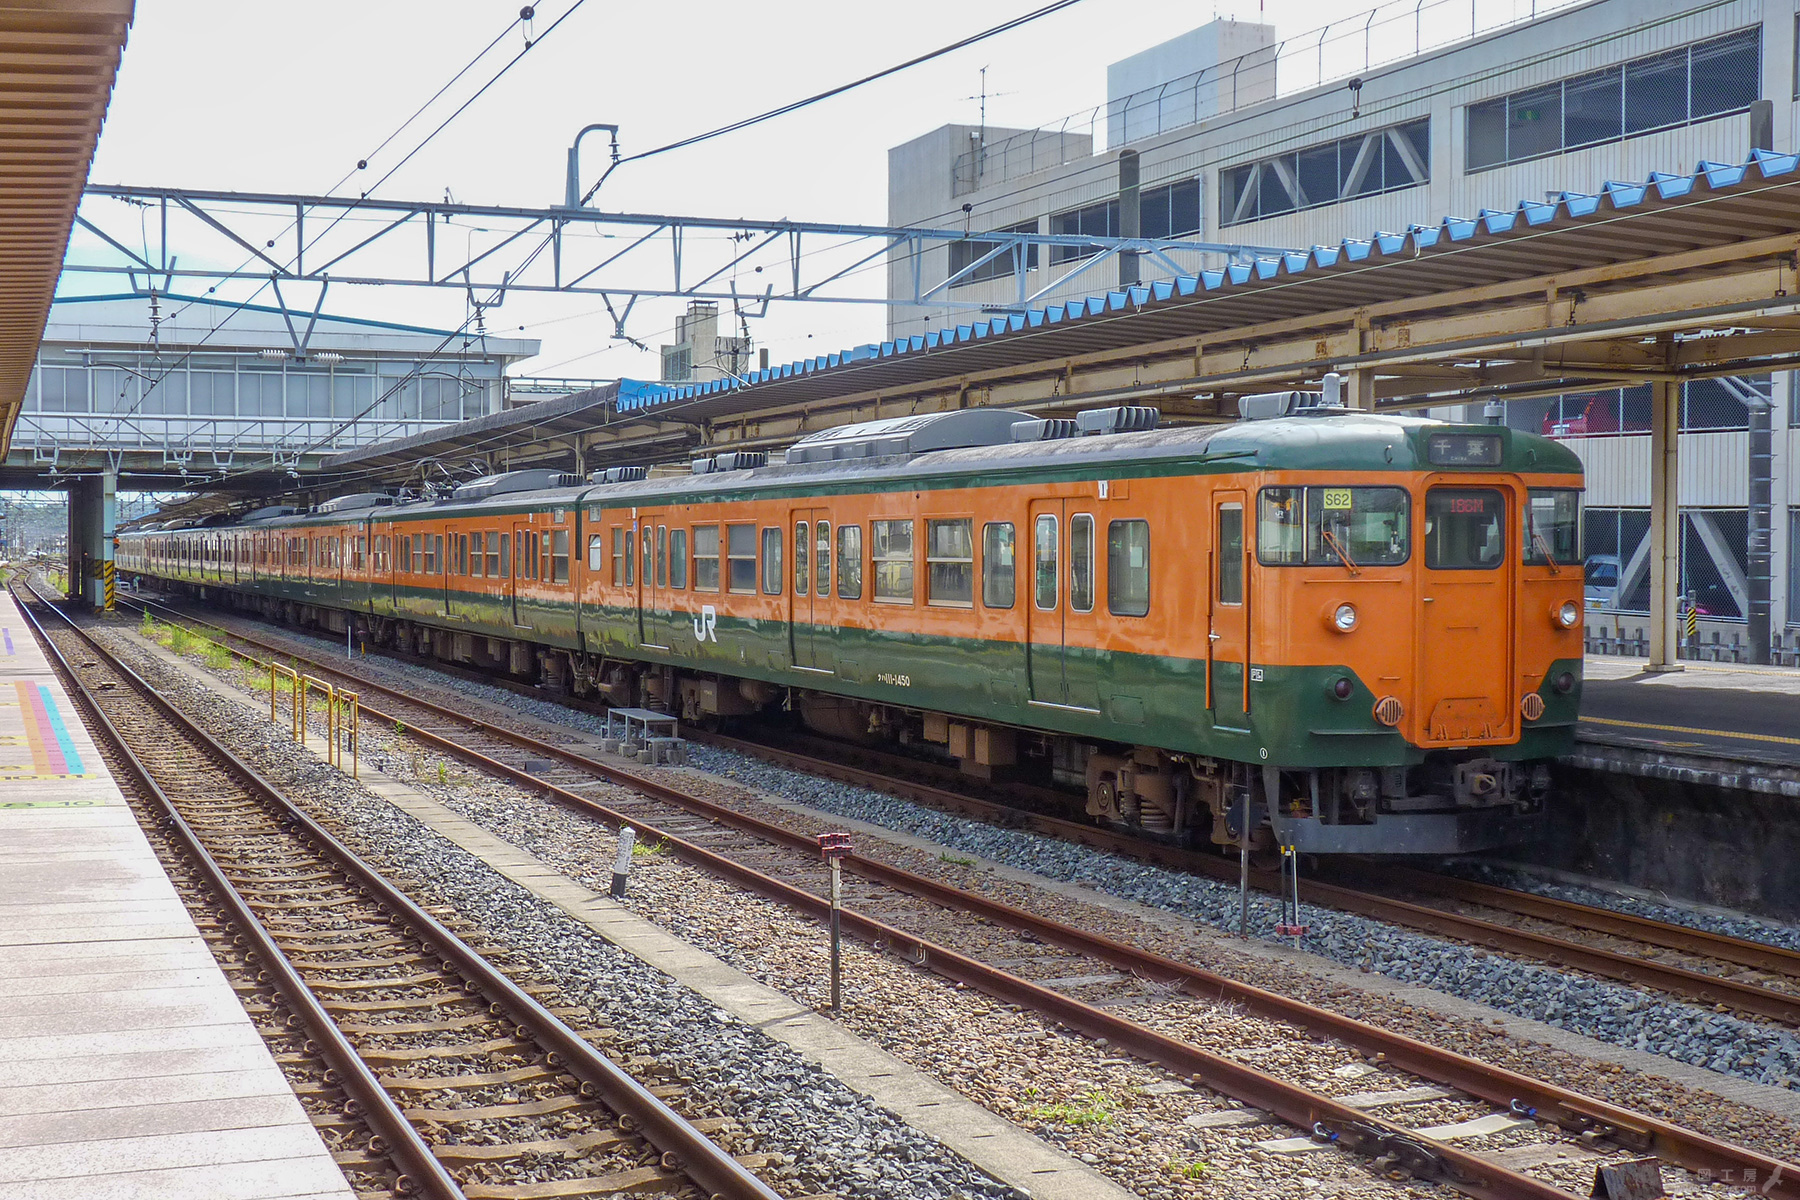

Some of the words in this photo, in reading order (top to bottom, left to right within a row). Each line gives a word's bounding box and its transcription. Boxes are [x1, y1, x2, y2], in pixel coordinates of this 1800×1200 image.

[1433, 439, 1484, 456] 千葉
[1325, 493, 1350, 506] S62
[1450, 498, 1484, 513] 186M
[694, 604, 718, 643] JR
